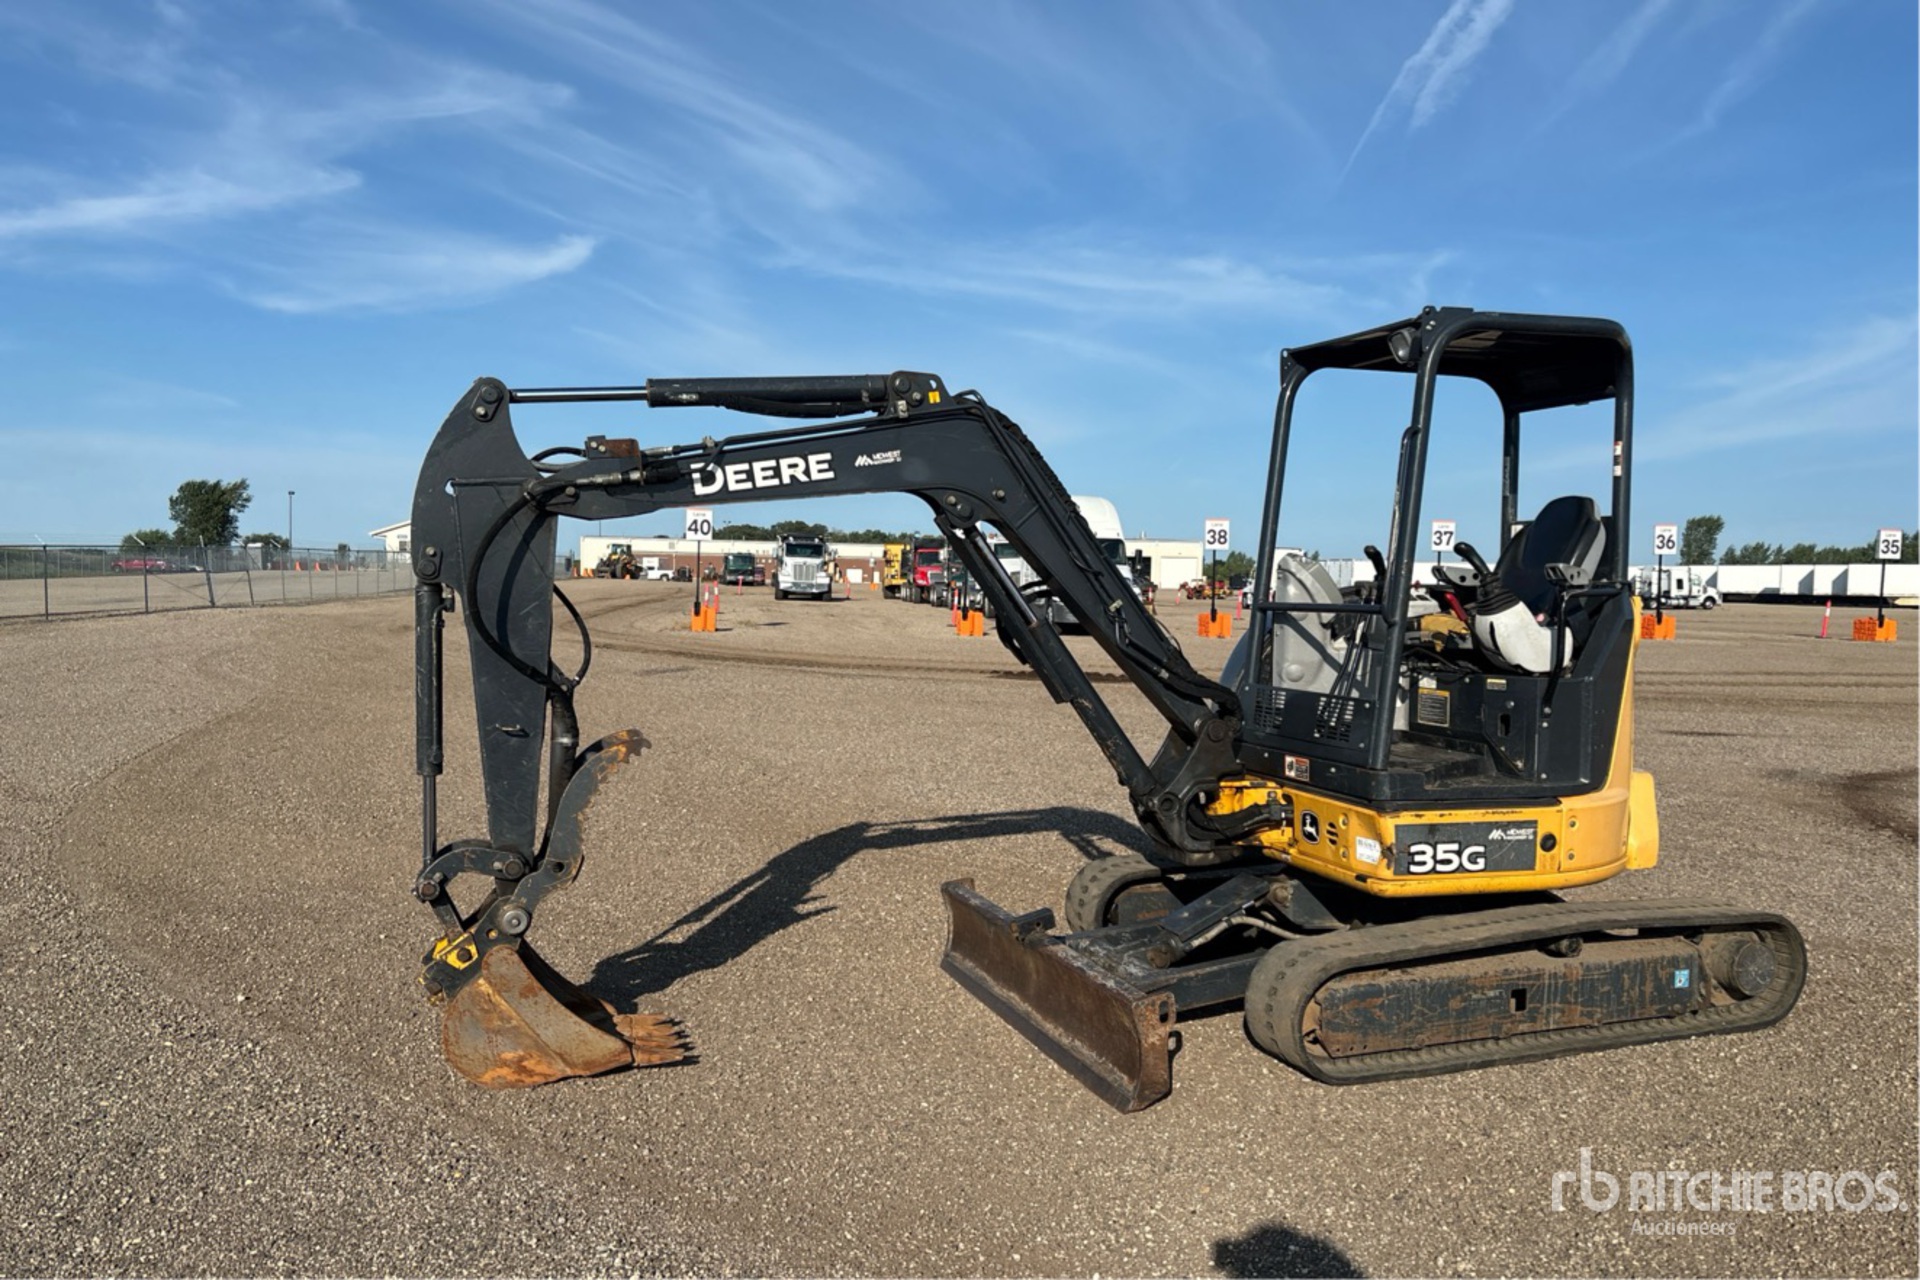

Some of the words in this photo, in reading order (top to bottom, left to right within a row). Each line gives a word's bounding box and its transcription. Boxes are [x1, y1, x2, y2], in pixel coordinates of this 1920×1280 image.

[690, 452, 835, 496] DEERE
[687, 519, 711, 535] 40
[1207, 529, 1228, 545] 38
[1433, 530, 1454, 546] 37
[1656, 534, 1675, 550] 36
[1881, 539, 1900, 555] 35
[1408, 843, 1486, 874] 35G
